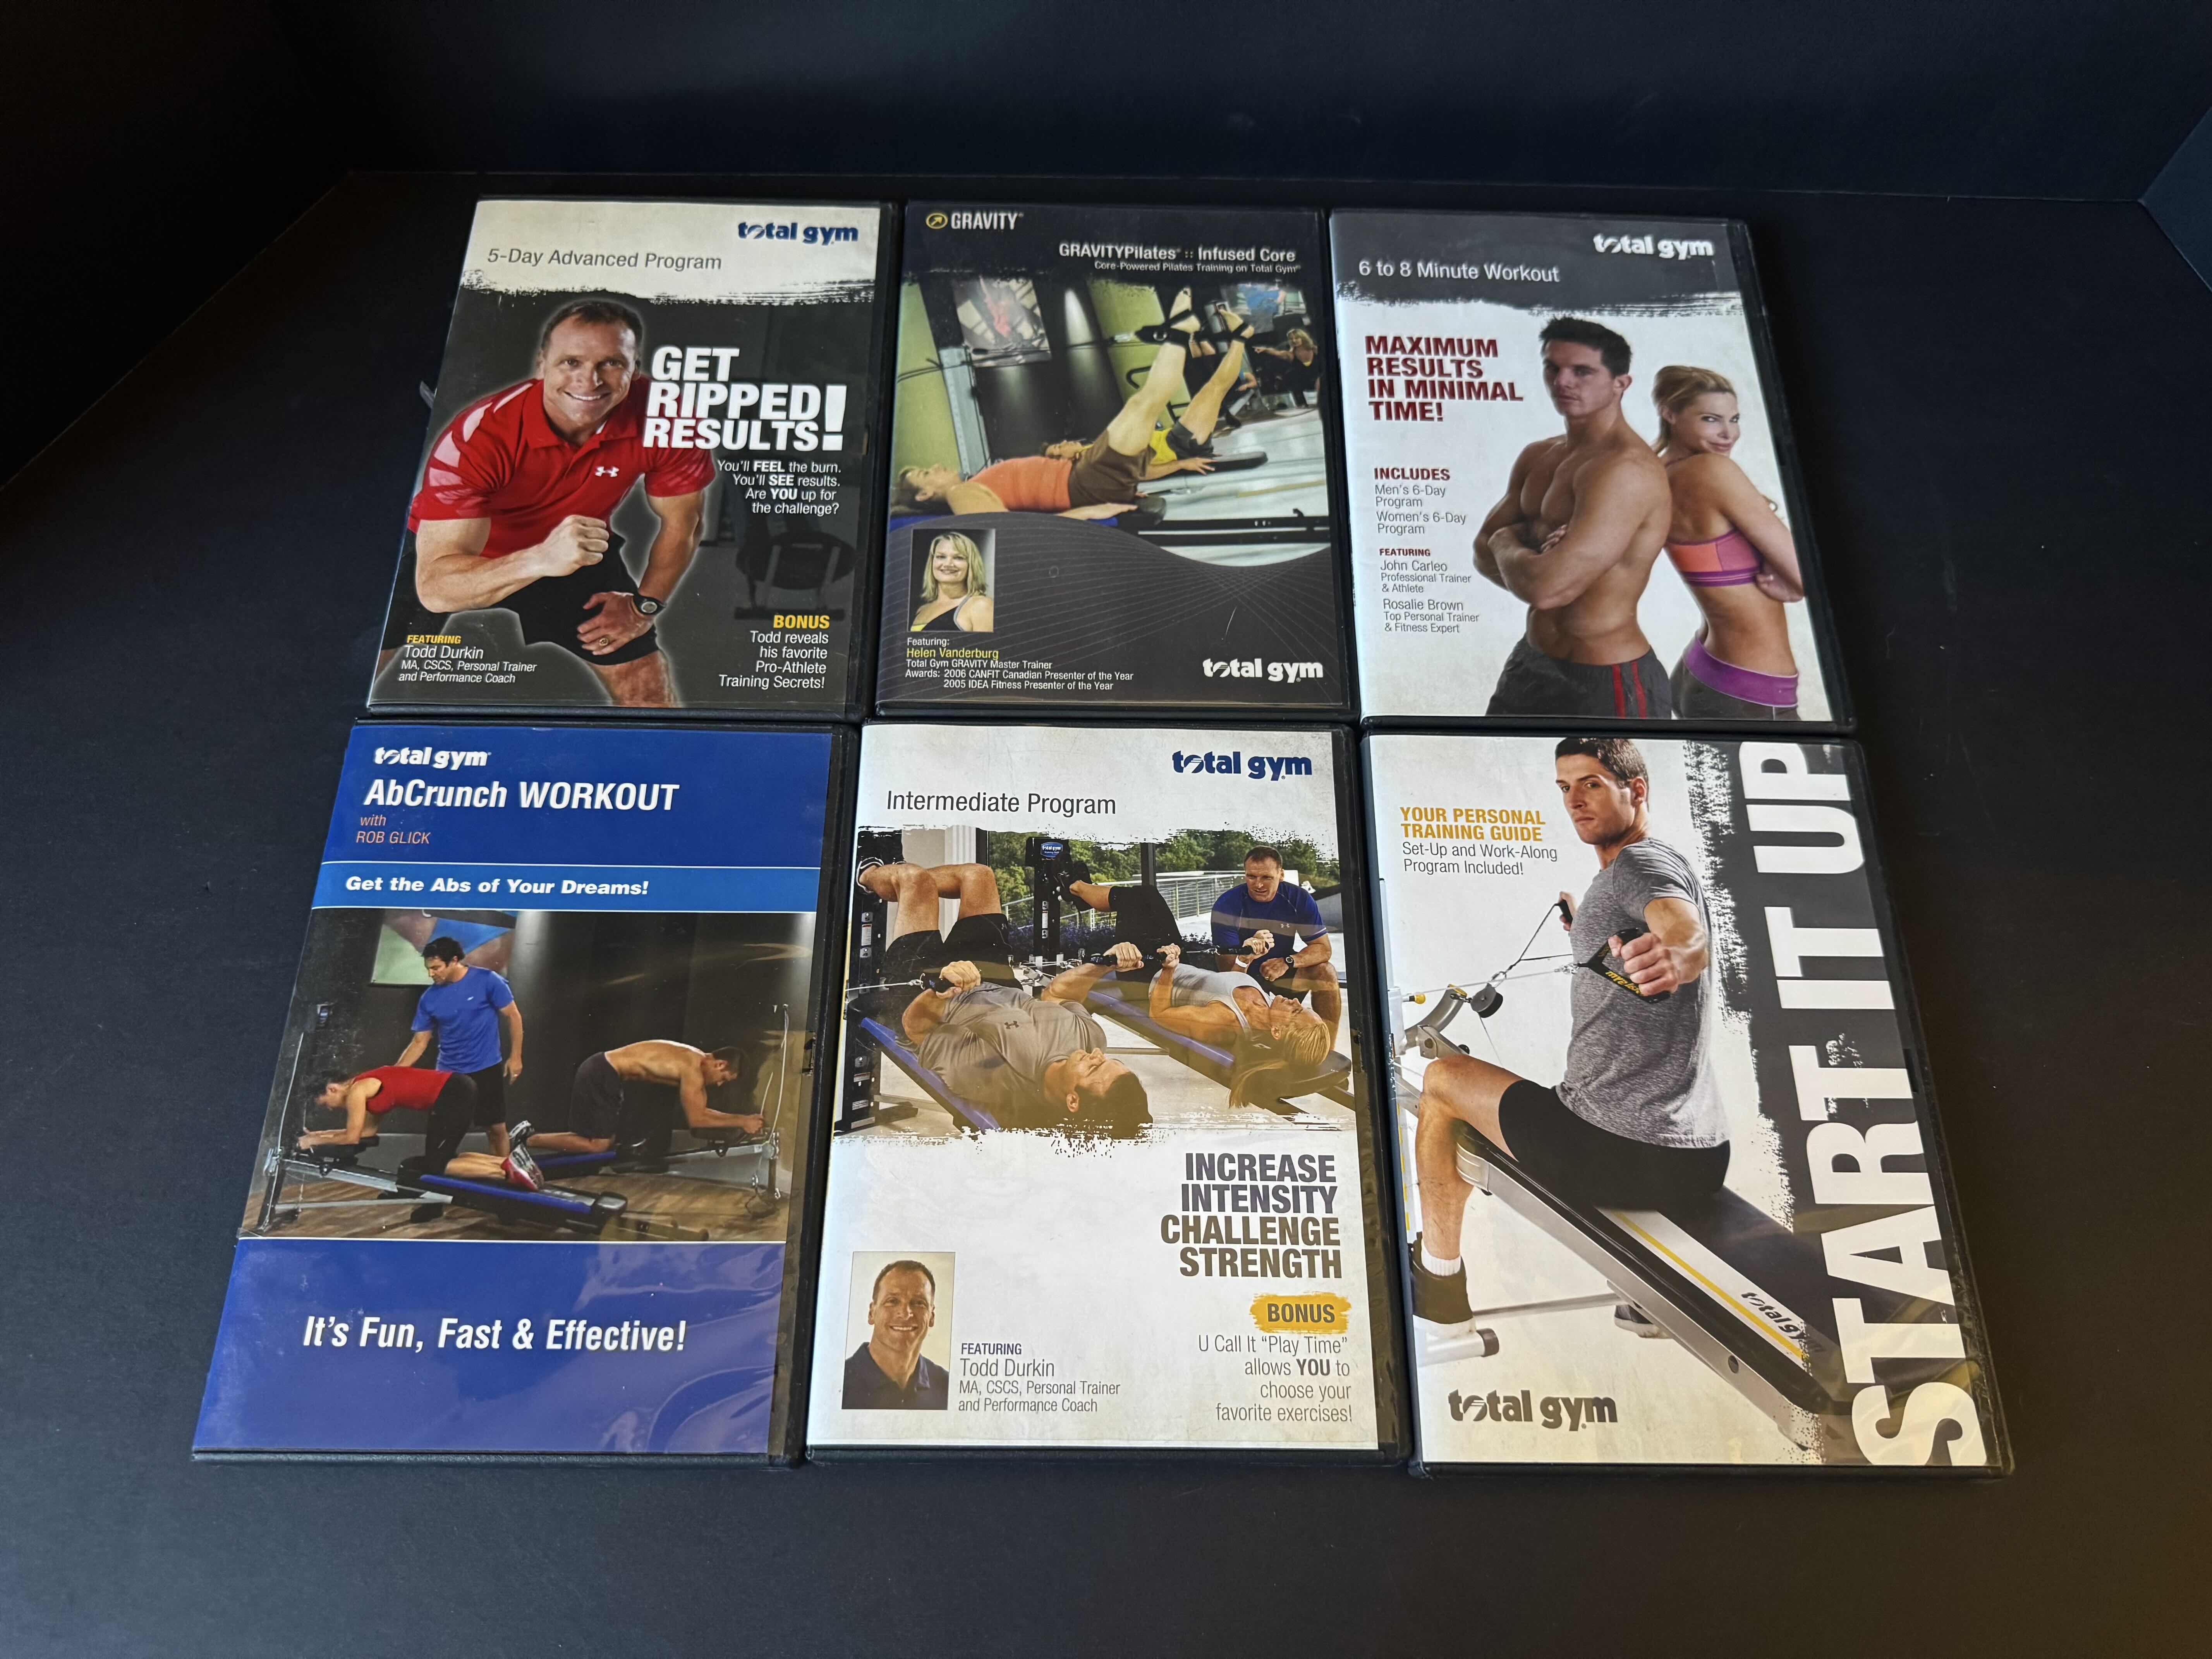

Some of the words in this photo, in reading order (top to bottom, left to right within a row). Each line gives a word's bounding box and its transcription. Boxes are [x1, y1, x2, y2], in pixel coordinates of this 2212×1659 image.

[951, 211, 1018, 230] GRAVITY
[738, 222, 798, 240] total
[803, 226, 859, 246] gym
[1198, 246, 1255, 261] Infused
[1260, 247, 1295, 262] Core
[1593, 234, 1654, 254] total
[1657, 239, 1714, 260] gym
[487, 248, 544, 267] 5-Day
[548, 249, 639, 267] Advanced
[645, 252, 721, 272] Program
[1094, 260, 1161, 271] Core-Powered
[1163, 262, 1194, 271] Pilates
[1196, 262, 1234, 274] Training
[1250, 263, 1273, 273] Total
[1359, 260, 1372, 276] 6
[1376, 260, 1395, 276] to
[1400, 261, 1412, 277] 8
[1417, 261, 1479, 279] Minute
[1483, 263, 1560, 282] Workout
[1365, 335, 1498, 357] MAXIMUM
[651, 346, 740, 381] GET
[1367, 357, 1483, 379] RESULTS
[1368, 379, 1395, 398] IN
[1404, 380, 1523, 401] MINIMAL
[646, 384, 821, 419] RIPPED
[1368, 401, 1443, 422] TIME!
[717, 459, 750, 472] You'll
[753, 460, 785, 472] FEEL
[789, 461, 808, 473] the
[811, 461, 841, 473] burn.
[1374, 467, 1450, 481] INCLUDES
[733, 474, 765, 486] You'll
[768, 474, 795, 486] SEE
[798, 475, 840, 487] results.
[1375, 484, 1409, 495] Men's
[1412, 484, 1446, 498] 6-Day
[1376, 496, 1422, 509] Program
[1379, 548, 1431, 556] FEATURING
[1380, 560, 1407, 571] John
[1412, 560, 1448, 572] Carleo
[1381, 572, 1437, 582] Professional
[1439, 574, 1472, 583] Trainer
[1383, 598, 1424, 610] Rosalie
[1427, 599, 1463, 611] Brown
[773, 615, 830, 629] BONUS
[1383, 611, 1401, 623] Top
[1404, 611, 1444, 622] Personal
[1446, 612, 1479, 622] Trainer
[407, 634, 461, 645] FEATURING
[750, 630, 781, 643] Todd
[785, 632, 829, 644] reveals
[907, 637, 950, 647] Featuring:
[403, 644, 437, 658] Todd
[440, 645, 484, 659] Durkin
[760, 646, 778, 658] his
[782, 646, 828, 659] favorite
[907, 647, 936, 658] Helen
[939, 647, 999, 660] Vanderburg
[401, 659, 420, 671] MA,
[423, 659, 453, 672] CSCS,
[457, 660, 500, 671] Personal
[503, 661, 538, 672] Trainer
[756, 660, 826, 674] Pro-Athlete
[906, 659, 927, 668] Total
[951, 658, 988, 668] GRAVITY
[990, 660, 1020, 669] Master
[1022, 660, 1053, 669] Trainer
[1202, 658, 1262, 678] total
[1267, 662, 1323, 683] gym
[719, 674, 769, 690] Training
[773, 675, 825, 689] Secrets!
[905, 669, 940, 678] Awards:
[944, 668, 966, 678] 2006
[969, 669, 1001, 678] CANFIT
[1002, 670, 1042, 679] Canadian
[1045, 670, 1085, 680] Presenter
[1087, 671, 1096, 680] of
[1098, 672, 1112, 680] the
[1114, 672, 1134, 680] Year
[374, 747, 433, 765] total
[432, 750, 488, 770] gym
[1172, 750, 1241, 774] total
[1247, 756, 1312, 781] gym
[363, 779, 507, 807] AbCrunch
[520, 781, 680, 811] WORKOUT
[887, 790, 1020, 812] Intermediate
[1028, 793, 1116, 818] Program
[1400, 807, 1447, 822] YOUR
[1453, 808, 1546, 825] PERSONAL
[1738, 741, 1865, 874] UP
[356, 831, 385, 843] ROB
[389, 831, 431, 844] GLICK
[1400, 823, 1484, 840] TRAINING
[1490, 826, 1543, 842] GUIDE
[1403, 842, 1447, 859] Set-Up
[1452, 844, 1476, 857] and
[1479, 844, 1557, 862] Work-Along
[1404, 859, 1460, 875] Program
[1464, 860, 1523, 875] Included!
[345, 876, 383, 891] Get
[390, 877, 424, 891] the
[430, 878, 471, 892] Abs
[478, 878, 501, 893] of
[507, 879, 555, 893] Your
[561, 880, 649, 895] Dreams!
[1764, 907, 1896, 1010] IT
[1185, 1153, 1336, 1183] INCREASE
[1181, 1183, 1338, 1214] INTENSITY
[1161, 1214, 1341, 1246] CHALLENGE
[1180, 1247, 1342, 1279] STRENGTH
[1788, 1045, 1987, 1466] START
[1267, 1303, 1335, 1323] BONUS
[303, 1316, 349, 1347] It's
[359, 1317, 423, 1353] Fun,
[438, 1318, 502, 1349] Fast
[512, 1318, 534, 1350] &
[546, 1319, 686, 1351] Effective!
[961, 1343, 1022, 1355] FEATURING
[1199, 1334, 1209, 1352] U
[1215, 1334, 1241, 1352] Call
[1247, 1335, 1256, 1353] It
[1262, 1336, 1299, 1357] "Play
[1304, 1336, 1347, 1353] Time"
[960, 1358, 998, 1376] Todd
[1005, 1358, 1054, 1377] Durkin
[1245, 1358, 1291, 1376] allows
[1296, 1358, 1330, 1376] YOU
[1335, 1360, 1350, 1376] to
[959, 1380, 981, 1396] MA,
[986, 1380, 1022, 1396] CSCS,
[1027, 1380, 1075, 1395] Personal
[1079, 1381, 1121, 1395] Trainer
[1261, 1381, 1314, 1398] choose
[1319, 1385, 1351, 1403] your
[958, 1397, 980, 1411] and
[984, 1398, 1058, 1413] Performance
[1062, 1398, 1097, 1412] Coach
[1216, 1403, 1271, 1421] favorite
[1278, 1404, 1352, 1422] exercises!
[1448, 1389, 1533, 1422] total
[1540, 1396, 1618, 1432] gym
